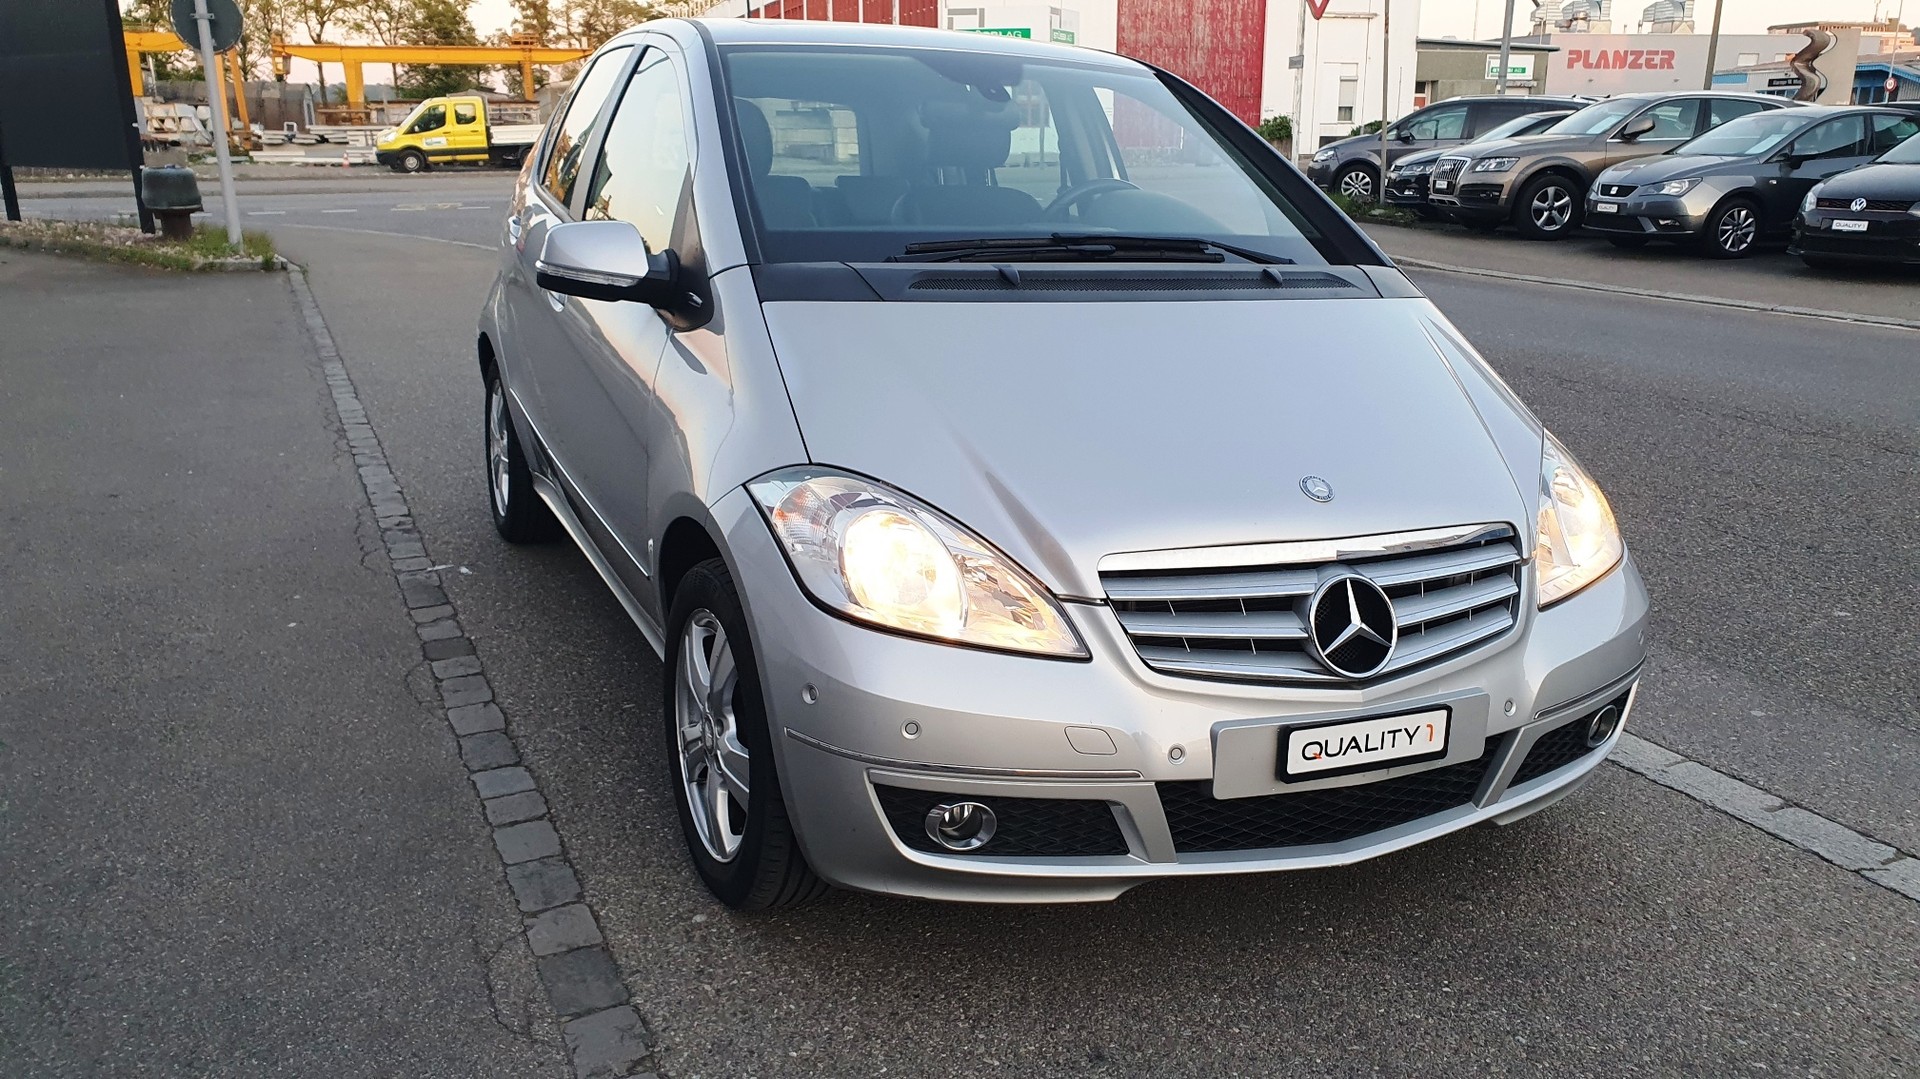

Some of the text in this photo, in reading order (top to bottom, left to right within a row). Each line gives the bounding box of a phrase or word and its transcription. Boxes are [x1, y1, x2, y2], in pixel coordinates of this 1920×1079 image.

[1567, 50, 1675, 69] PLANZER
[1302, 723, 1434, 760] QUALITY 1
